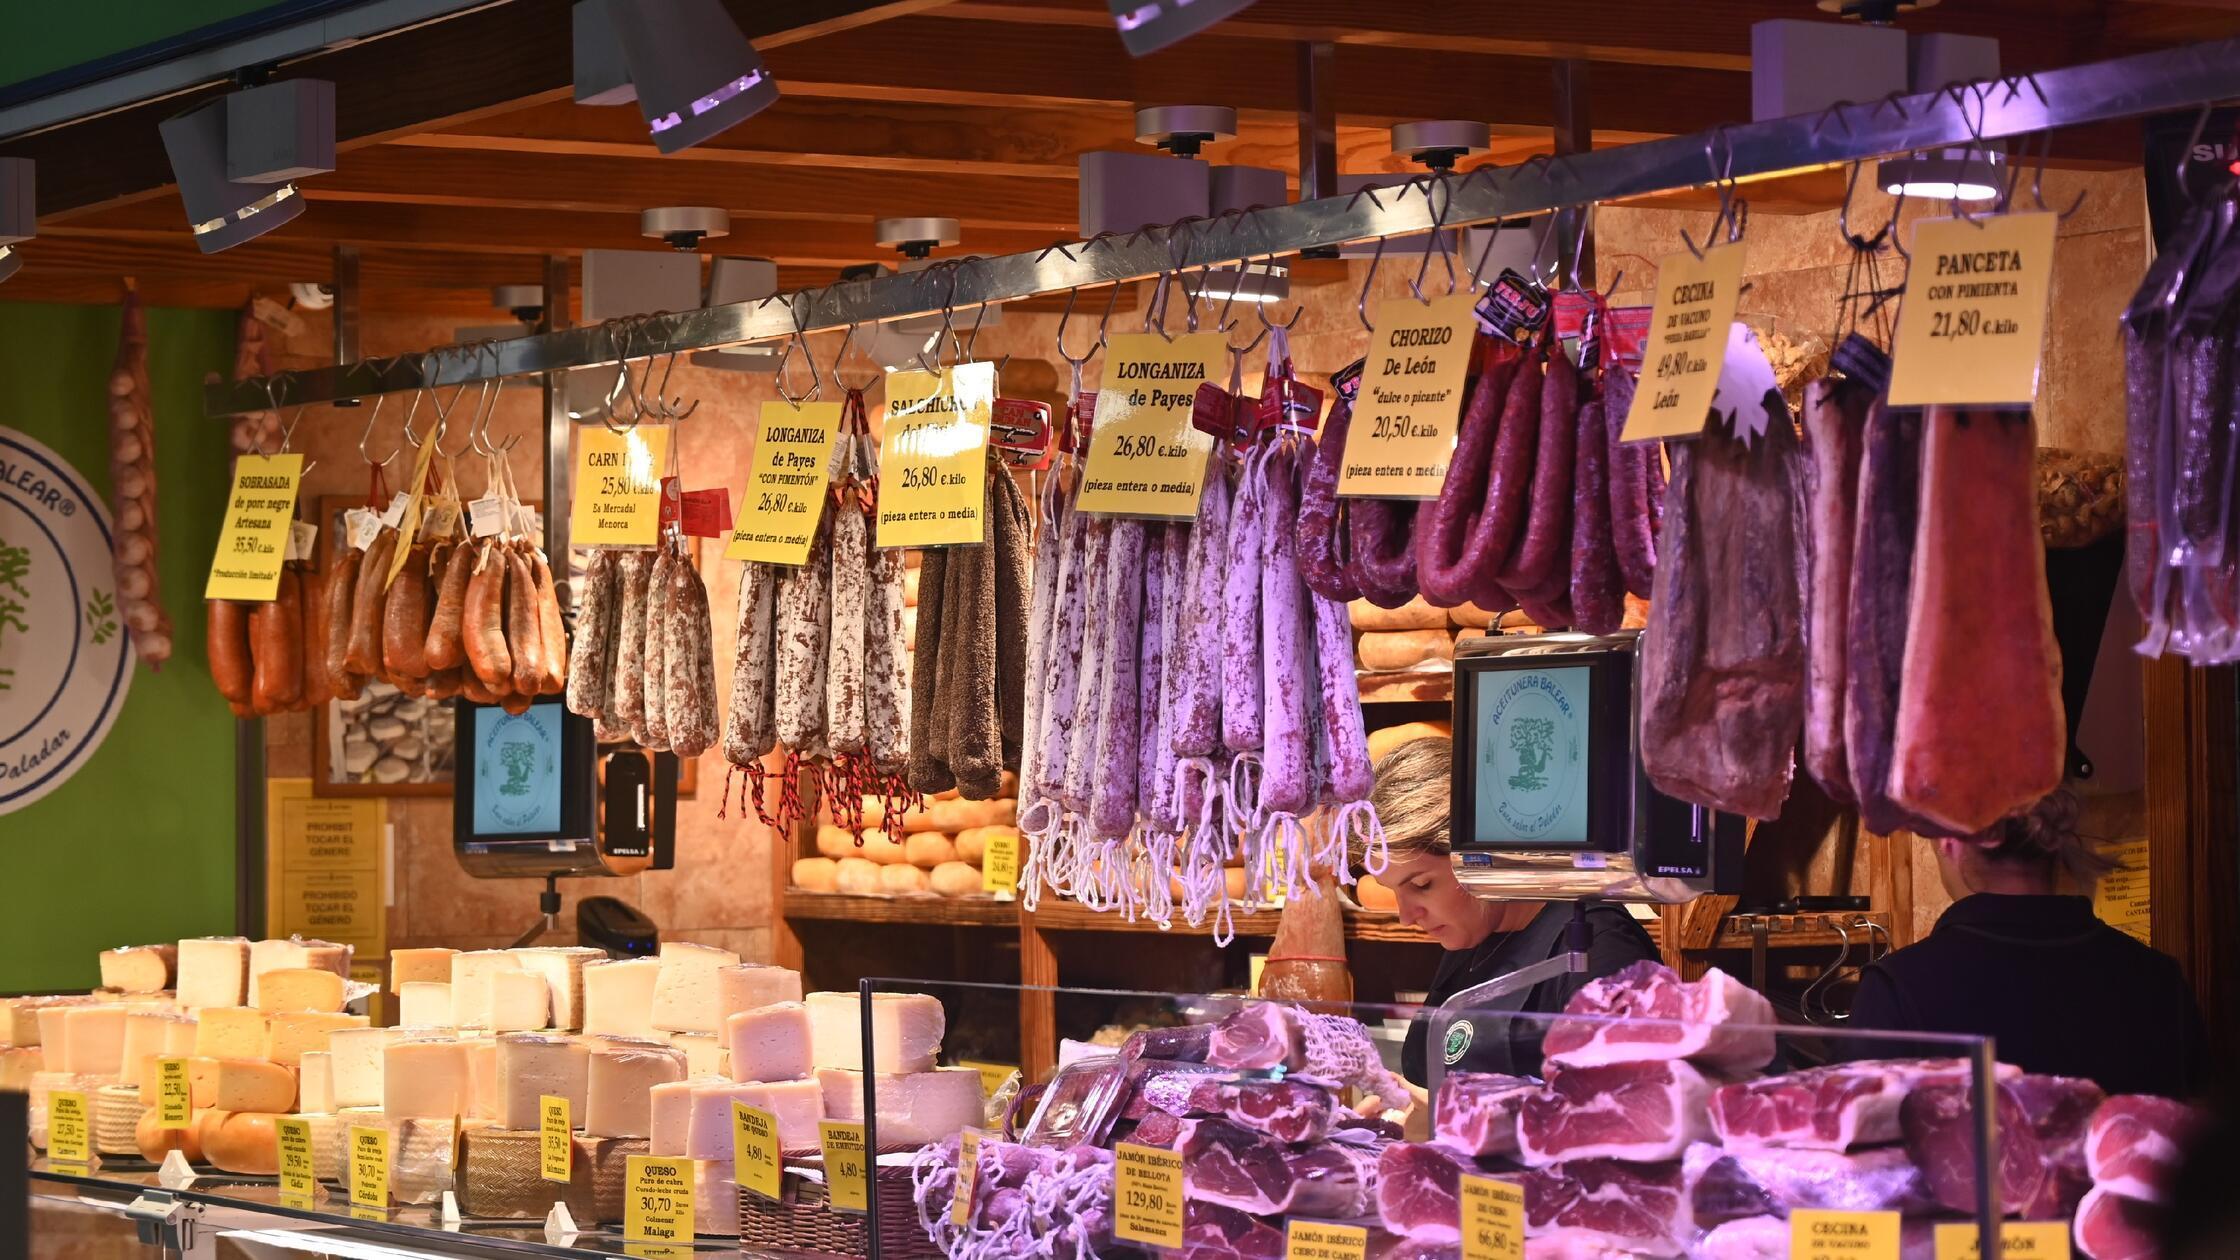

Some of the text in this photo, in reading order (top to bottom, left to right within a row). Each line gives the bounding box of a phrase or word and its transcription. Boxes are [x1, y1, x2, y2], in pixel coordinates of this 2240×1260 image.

[1936, 251, 2022, 276] PANCETA
[1673, 281, 1715, 305] CECINA
[1928, 282, 2019, 301] CON PIMIENTA
[1667, 310, 1711, 328] DE VACUNO
[1930, 310, 1981, 341] 21,80
[1390, 326, 1453, 348] CHORIZO
[1117, 362, 1206, 379] LONGANIZA
[1383, 355, 1436, 376] De León
[1656, 352, 1688, 382] 49,80
[1129, 389, 1193, 411] de Payes
[1403, 394, 1410, 403] o
[1653, 389, 1680, 410] León
[766, 427, 825, 444] LONGANIZA
[1372, 415, 1411, 442] 20,50
[1113, 435, 1188, 460] 26,80 €.kilo
[588, 453, 618, 467] CARN
[772, 452, 815, 471] de Payes
[902, 465, 937, 491] 26,80
[1346, 464, 1372, 479] (pieza
[1375, 465, 1404, 477] entera
[1406, 467, 1413, 476] o
[239, 476, 290, 489] SOBRASADA
[601, 477, 630, 497] 25,80
[1084, 479, 1195, 496] (pieza entera o media)
[235, 496, 290, 513] de porc negre
[593, 504, 636, 513] Es Mercadal
[757, 492, 788, 515] 26,80
[235, 517, 271, 529] Artesana
[881, 506, 978, 524] (pieza entera o media)
[598, 519, 628, 528] Menorca
[233, 537, 258, 554] 35,50
[732, 530, 753, 542] (pieza
[755, 532, 777, 543] entera
[785, 534, 809, 547] media)
[306, 822, 353, 832] PROHIBIT
[305, 835, 354, 844] TOCAR EL
[1657, 866, 1693, 874] EPELSA
[303, 890, 358, 900] PROHIBIDO
[305, 903, 355, 912] TOCAR EL
[58, 1098, 77, 1108] QUESO
[548, 1106, 562, 1117] QUESO
[739, 1111, 768, 1129] BANDEJA
[283, 1126, 301, 1136] QUESO
[743, 1124, 768, 1138] DE QUESO
[828, 1130, 860, 1142] BANDEJA
[359, 1136, 378, 1146] QUESO
[548, 1136, 561, 1152] 35,50
[827, 1141, 865, 1151] DE EMBUTIDO
[746, 1143, 762, 1161] 4,80
[1117, 1150, 1183, 1169] JAMÓN IBÉRICO
[358, 1164, 376, 1178] 30,70
[645, 1165, 677, 1177] QUESO
[839, 1162, 857, 1177] 4,80
[1126, 1167, 1171, 1183] DE BELLOTA
[640, 1177, 654, 1185] Puro
[358, 1190, 379, 1202] Córdoba
[635, 1186, 689, 1195] Curado-leche cruda
[1464, 1184, 1522, 1204] JAMÓN IBÉRICO
[640, 1197, 671, 1213] 30,70
[1126, 1190, 1163, 1211] 129,80
[1478, 1203, 1487, 1212] DE
[646, 1216, 675, 1224] Colmenar
[643, 1226, 675, 1238] Malaga
[1129, 1223, 1167, 1236] Salamanca
[1812, 1222, 1868, 1236] CECINA
[1292, 1228, 1364, 1248] JAMÓN IBÉRICO
[1478, 1229, 1507, 1249] 66,80
[1812, 1240, 1870, 1250] DE VACUNO
[1293, 1246, 1361, 1260] CEBO DE CAMPO
